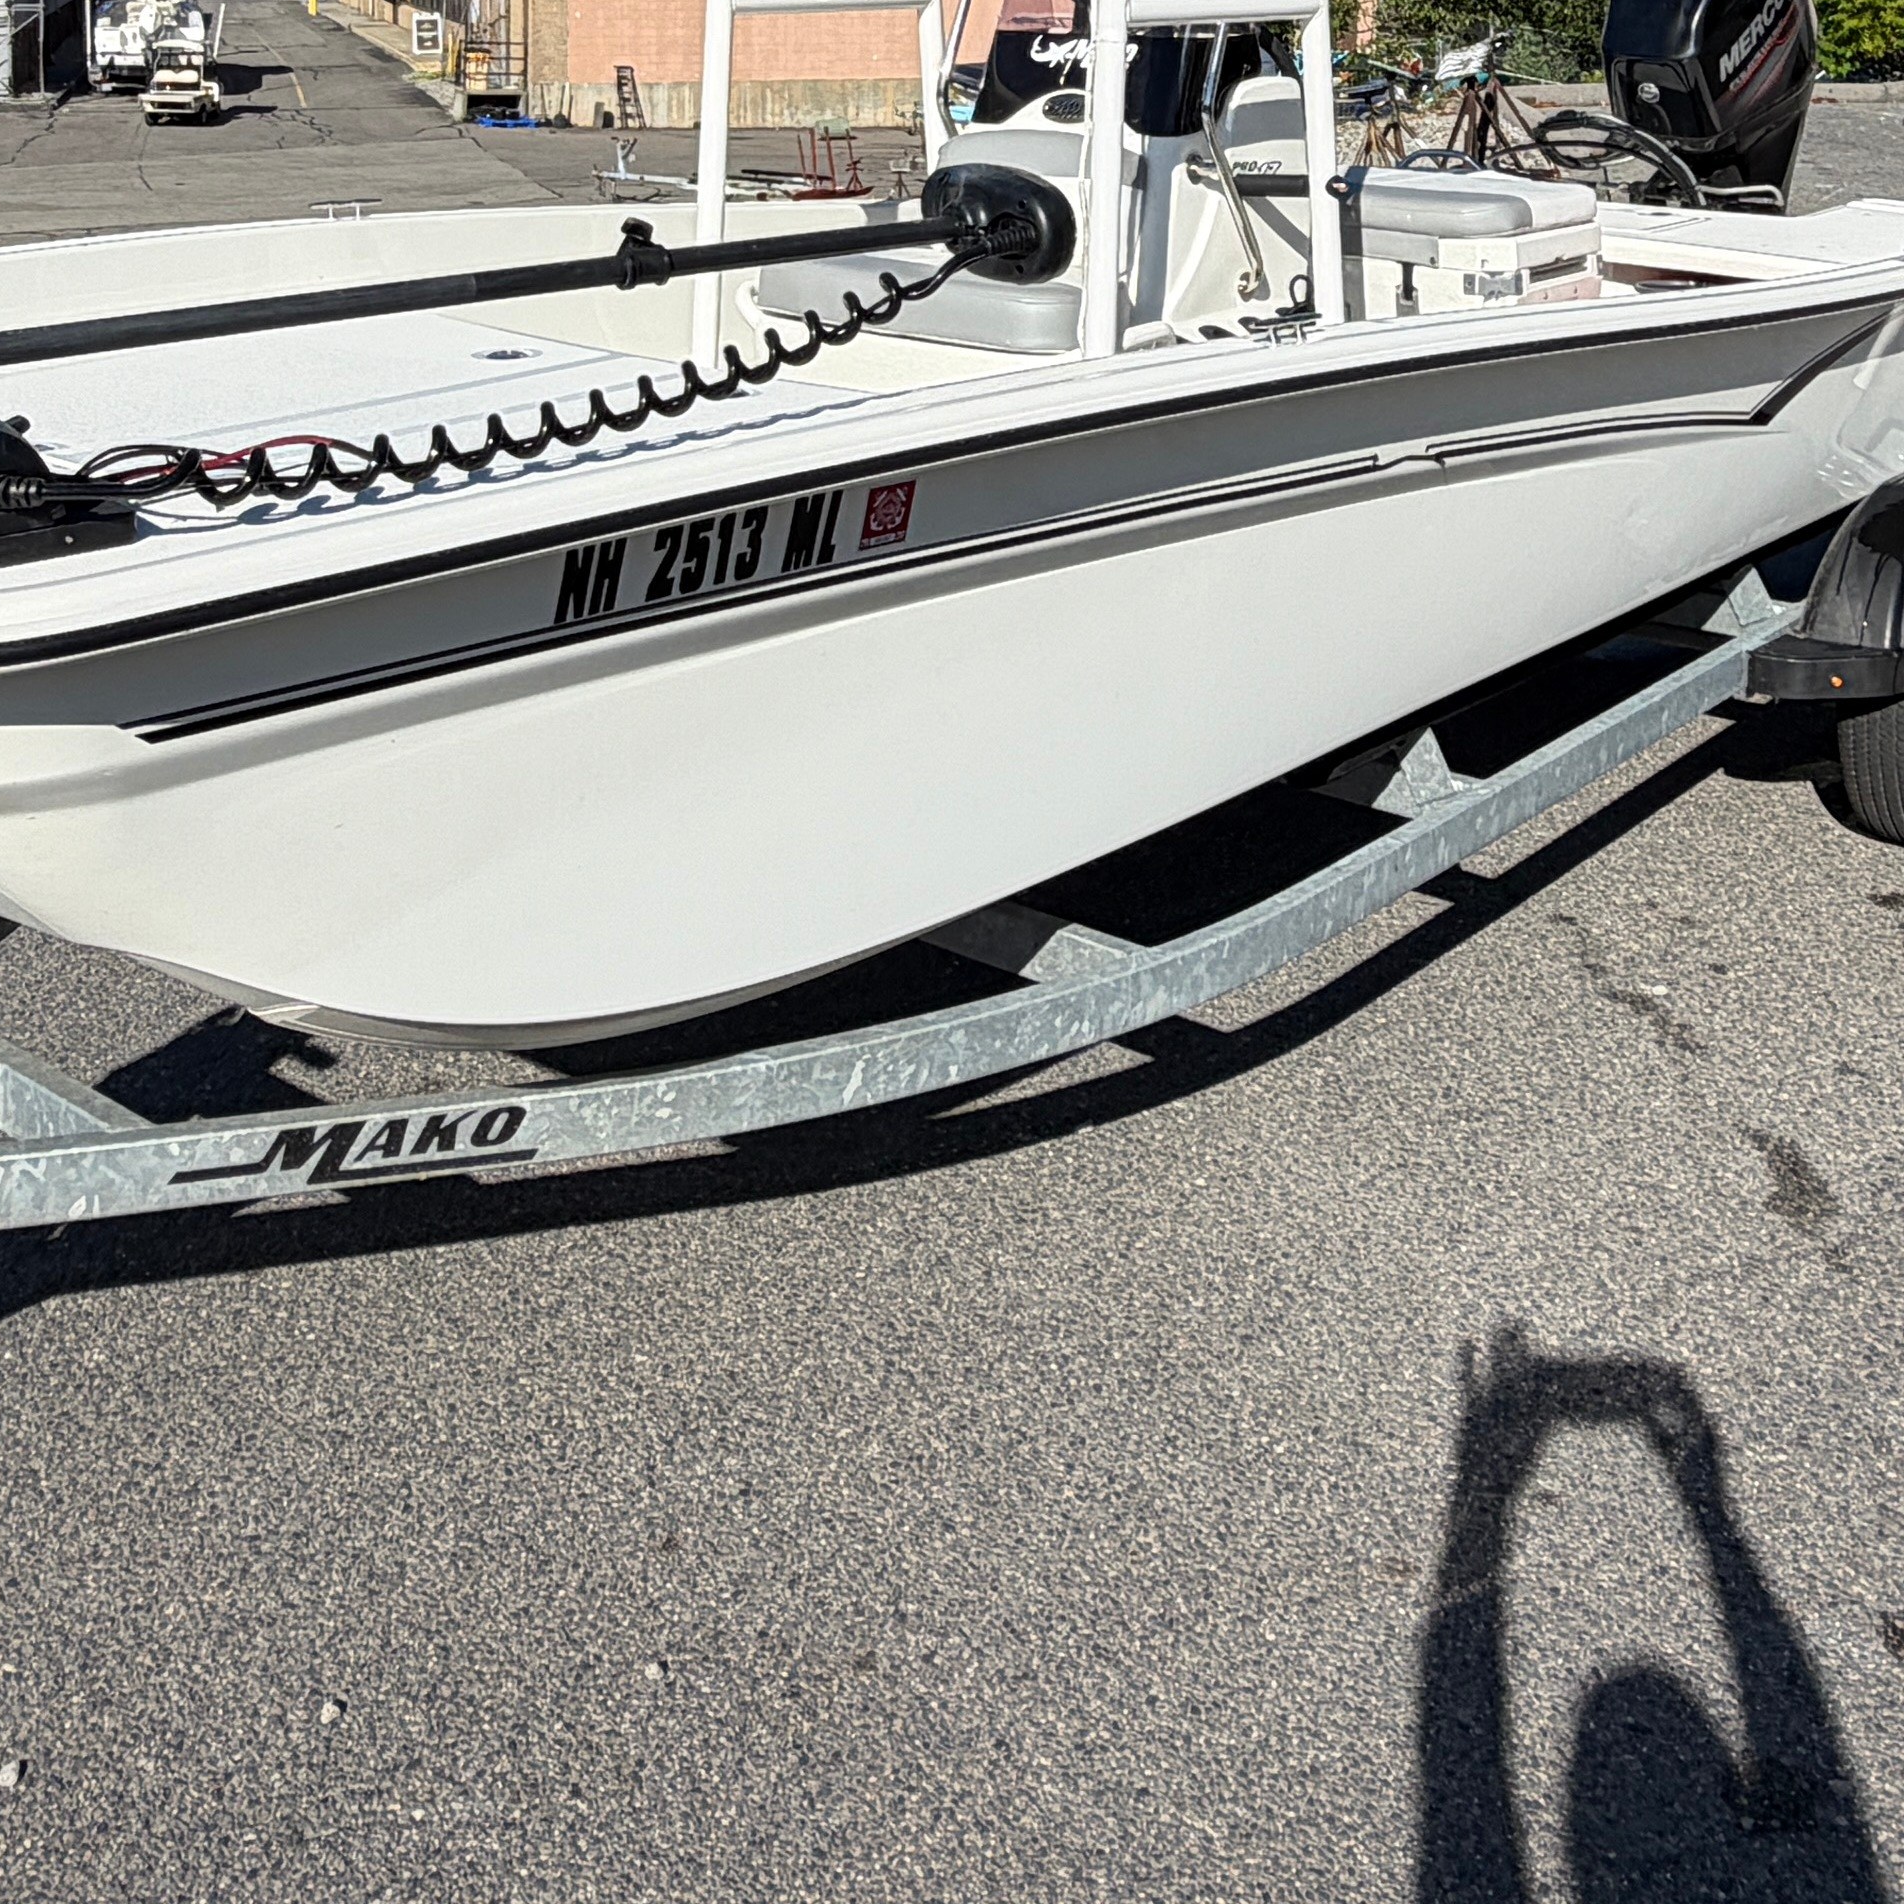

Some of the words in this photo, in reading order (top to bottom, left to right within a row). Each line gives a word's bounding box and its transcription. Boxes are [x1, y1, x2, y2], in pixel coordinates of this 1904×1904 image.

[553, 537, 628, 625] NH
[644, 505, 770, 603] 2513
[780, 489, 844, 574] ML
[167, 1106, 538, 1176] MAKO
